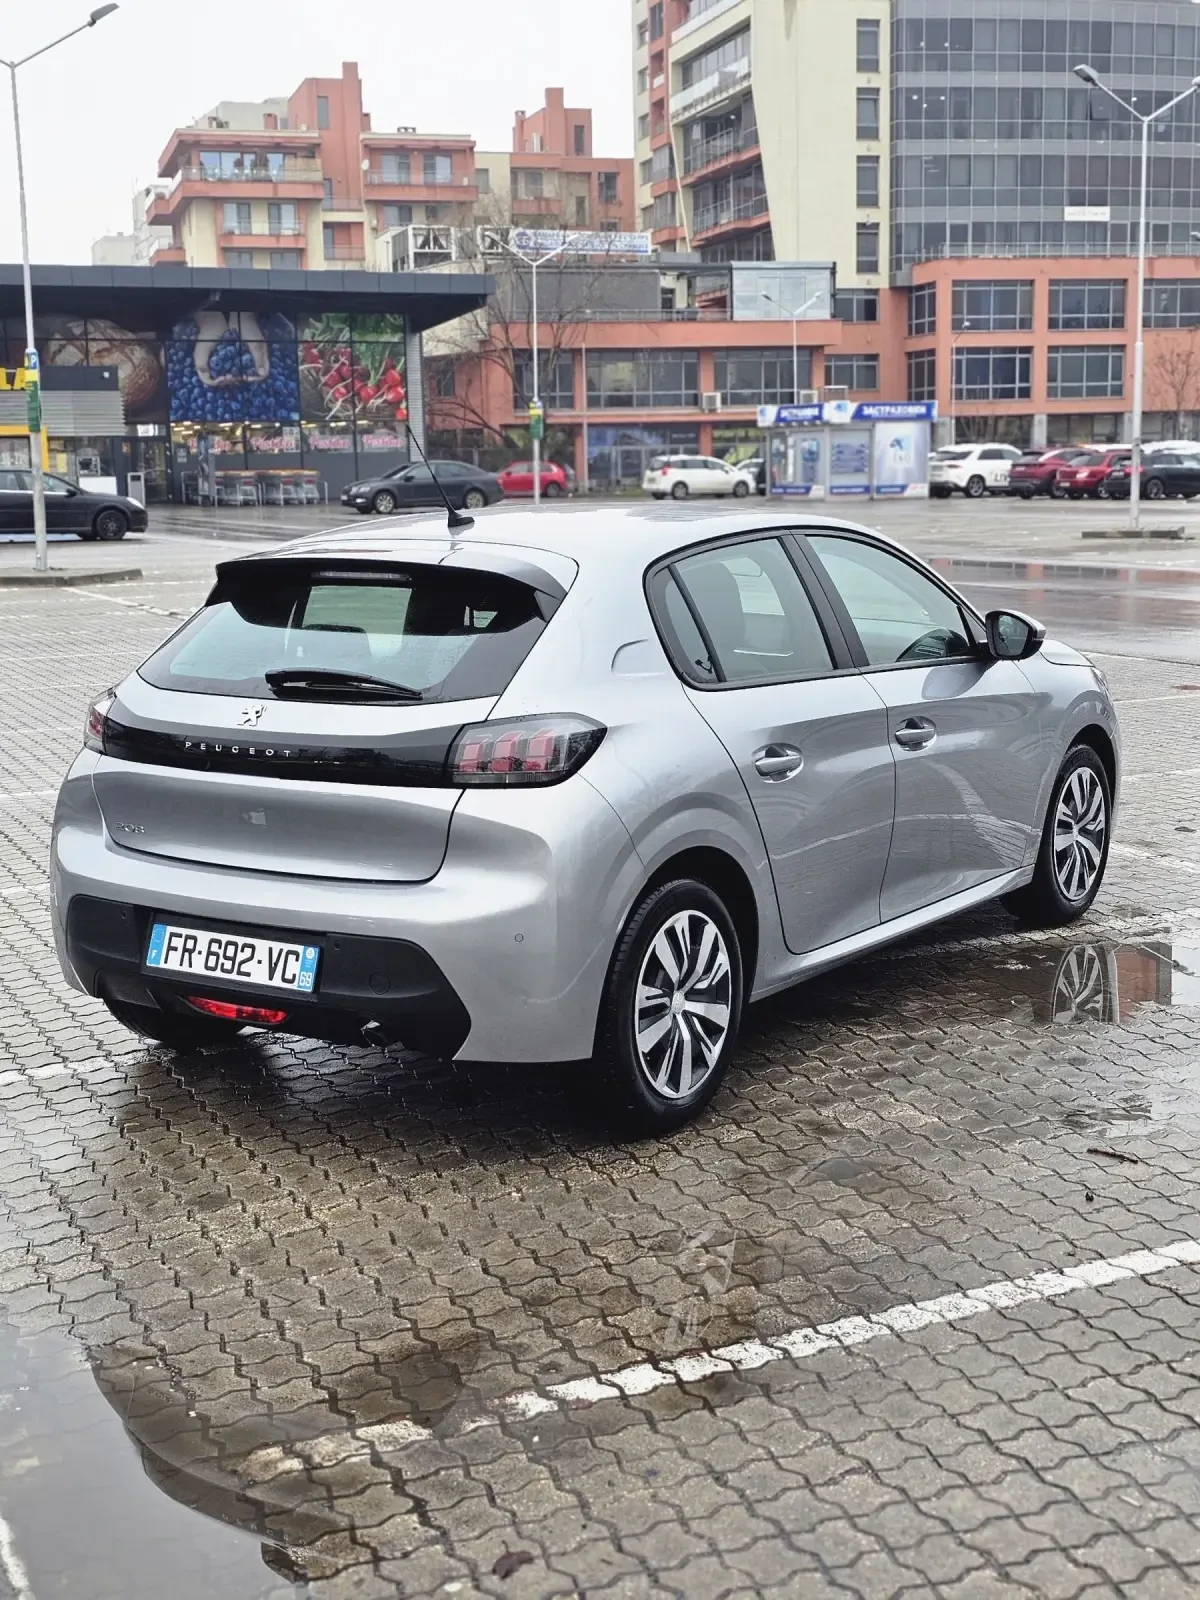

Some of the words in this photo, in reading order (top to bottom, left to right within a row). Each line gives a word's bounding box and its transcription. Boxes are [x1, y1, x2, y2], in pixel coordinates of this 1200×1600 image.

[185, 741, 291, 758] PEUGEOT
[115, 821, 145, 835] 208
[151, 950, 157, 959] F
[163, 931, 300, 984] FR-692-VC
[299, 971, 313, 987] 69
